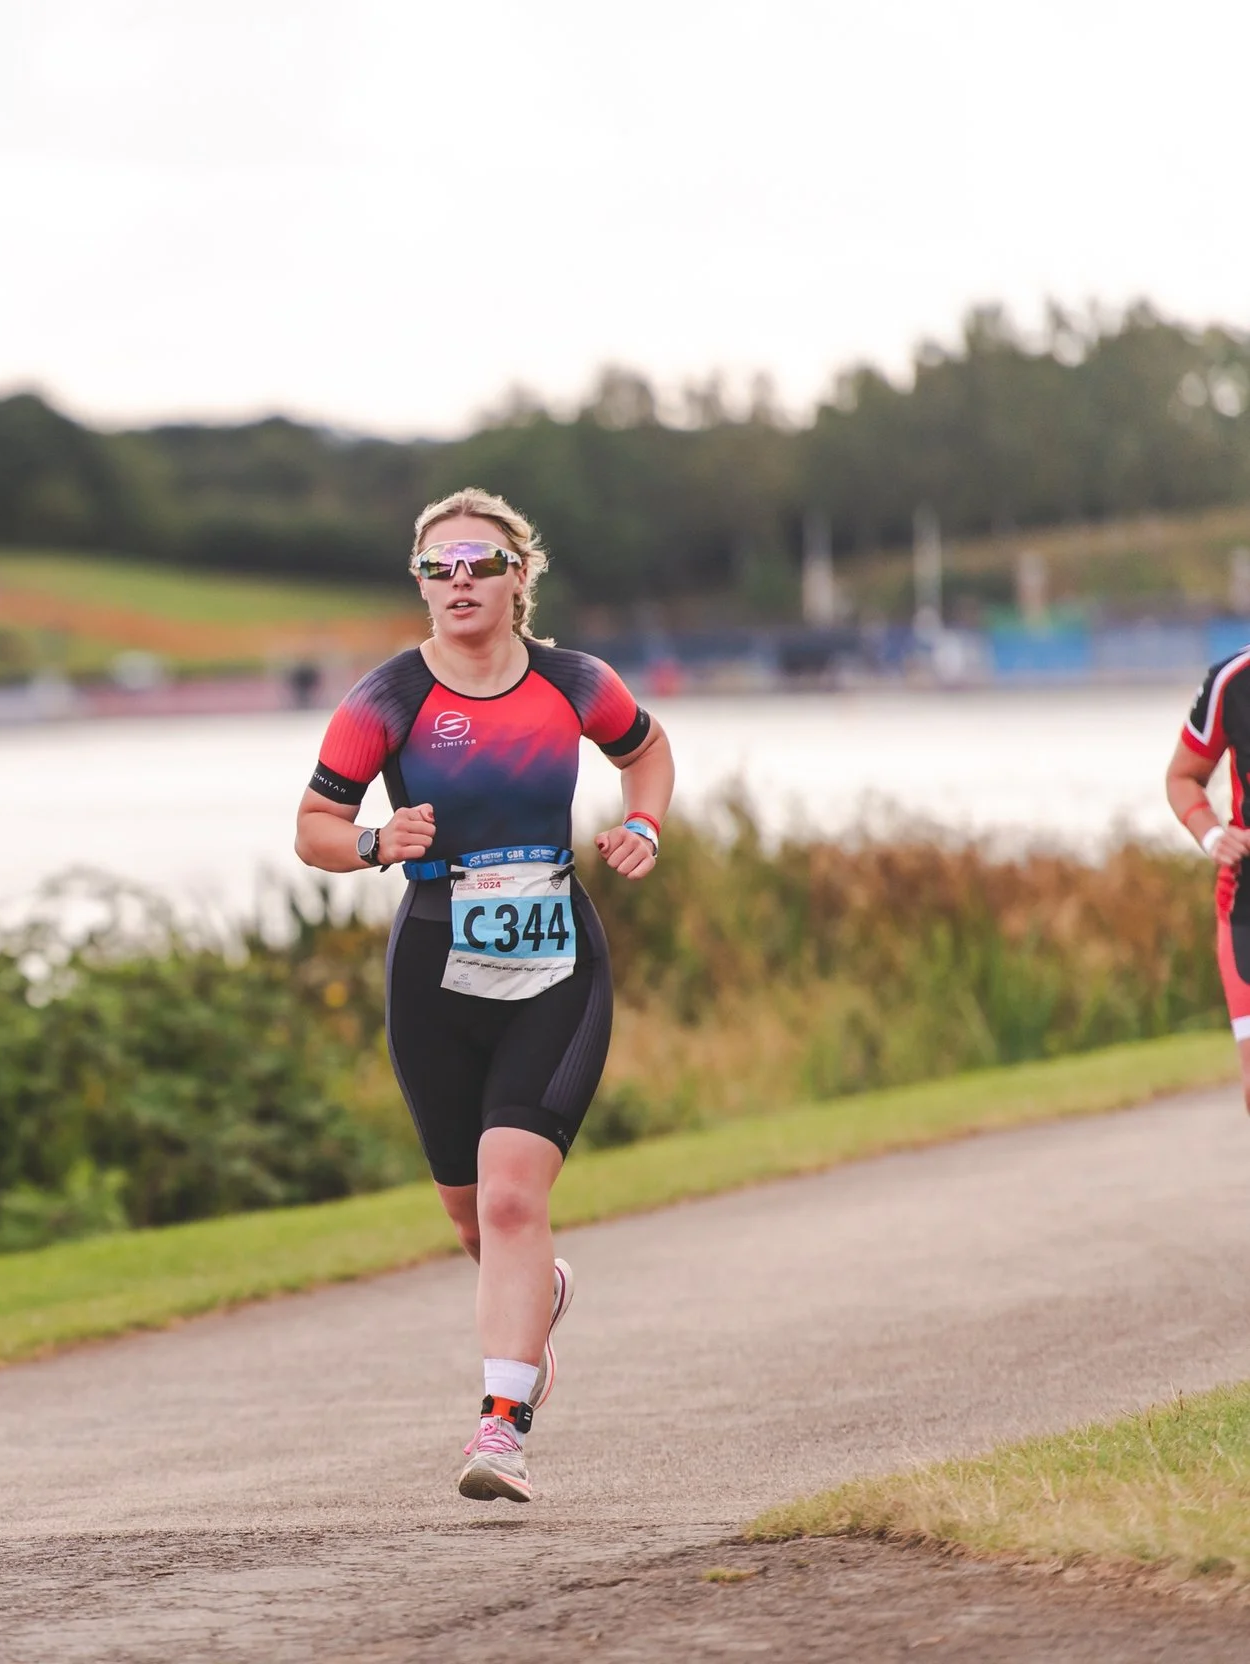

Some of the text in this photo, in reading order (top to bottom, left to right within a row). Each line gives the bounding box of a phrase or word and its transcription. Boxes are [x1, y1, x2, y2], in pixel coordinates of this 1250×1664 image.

[431, 739, 477, 749] SCIMITAR
[481, 852, 503, 860] BRITISH
[507, 850, 524, 858] GBR
[477, 881, 501, 890] 2024
